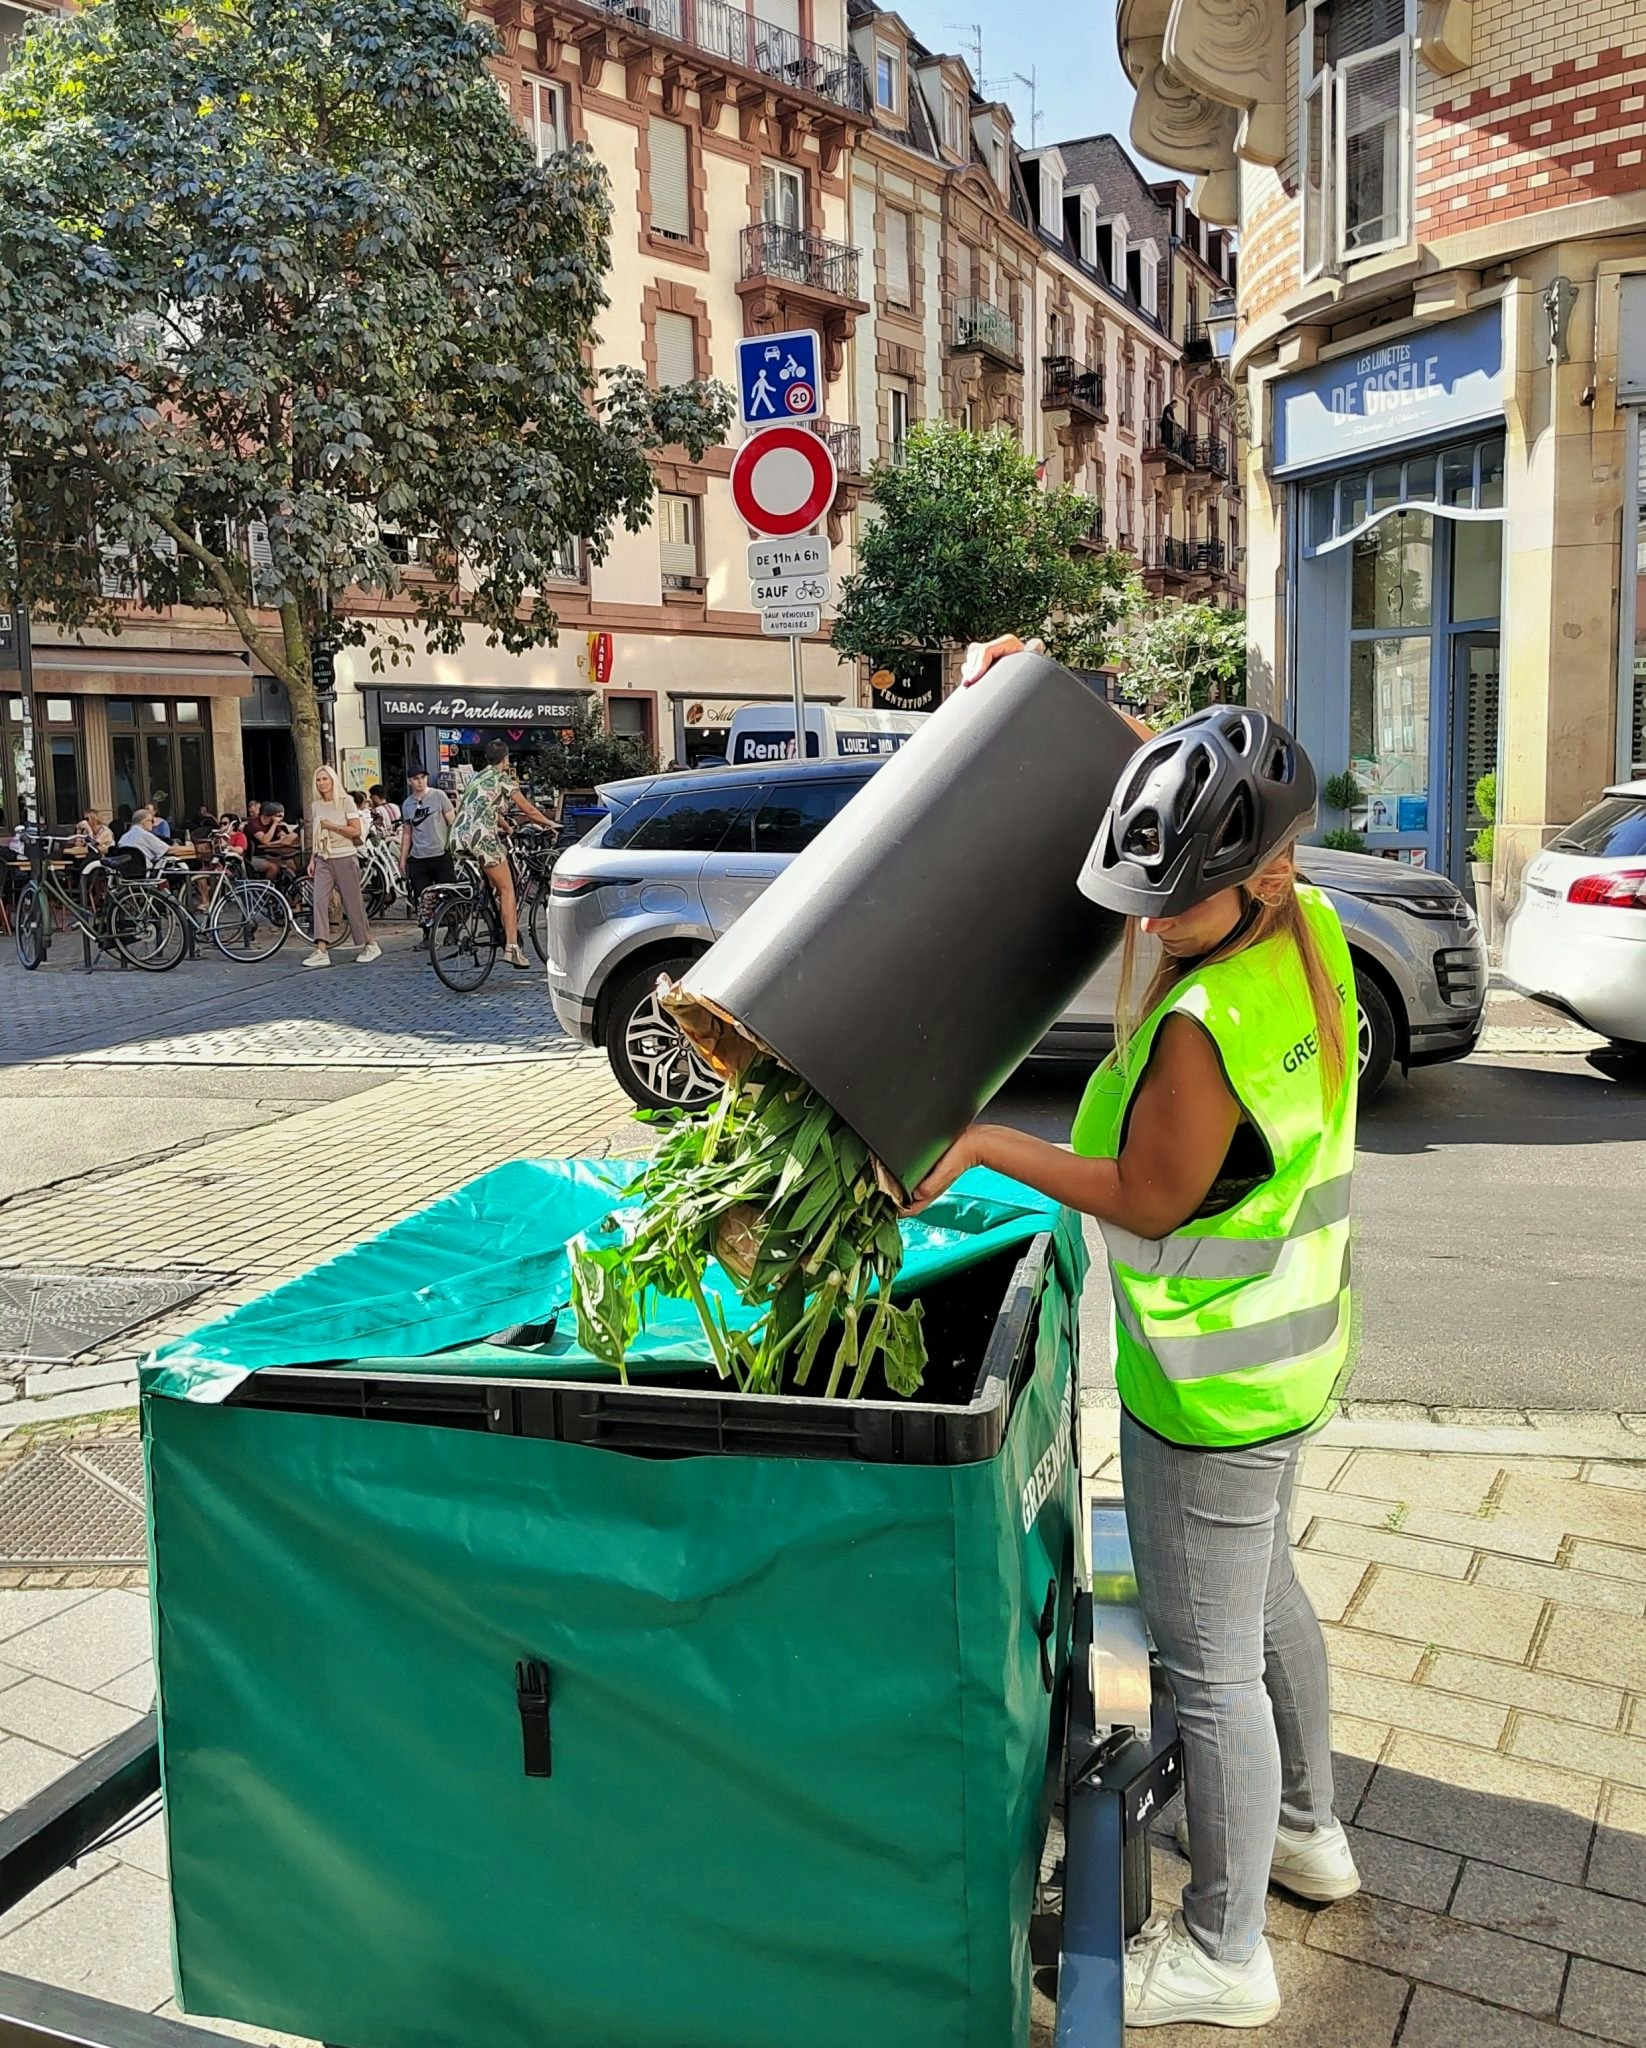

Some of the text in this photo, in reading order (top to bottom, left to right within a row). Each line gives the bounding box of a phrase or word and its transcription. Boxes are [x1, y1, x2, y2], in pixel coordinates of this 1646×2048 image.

[1357, 344, 1411, 376] LES LUNETTES
[792, 392, 808, 404] 20
[1331, 381, 1361, 426] DE
[757, 555, 770, 566] DE
[773, 552, 792, 564] 11h
[804, 550, 820, 561] 6h
[757, 585, 789, 599] SAUF
[782, 610, 815, 619] VÉHICULES
[770, 621, 808, 629] AUTORISÉS
[597, 636, 606, 679] TABAC
[902, 677, 911, 688] et
[880, 688, 933, 709] TENTATIONS
[383, 701, 425, 714] TABAC
[427, 699, 450, 716] Au
[451, 698, 535, 719] Parchemin
[842, 738, 869, 753] LOUEZ
